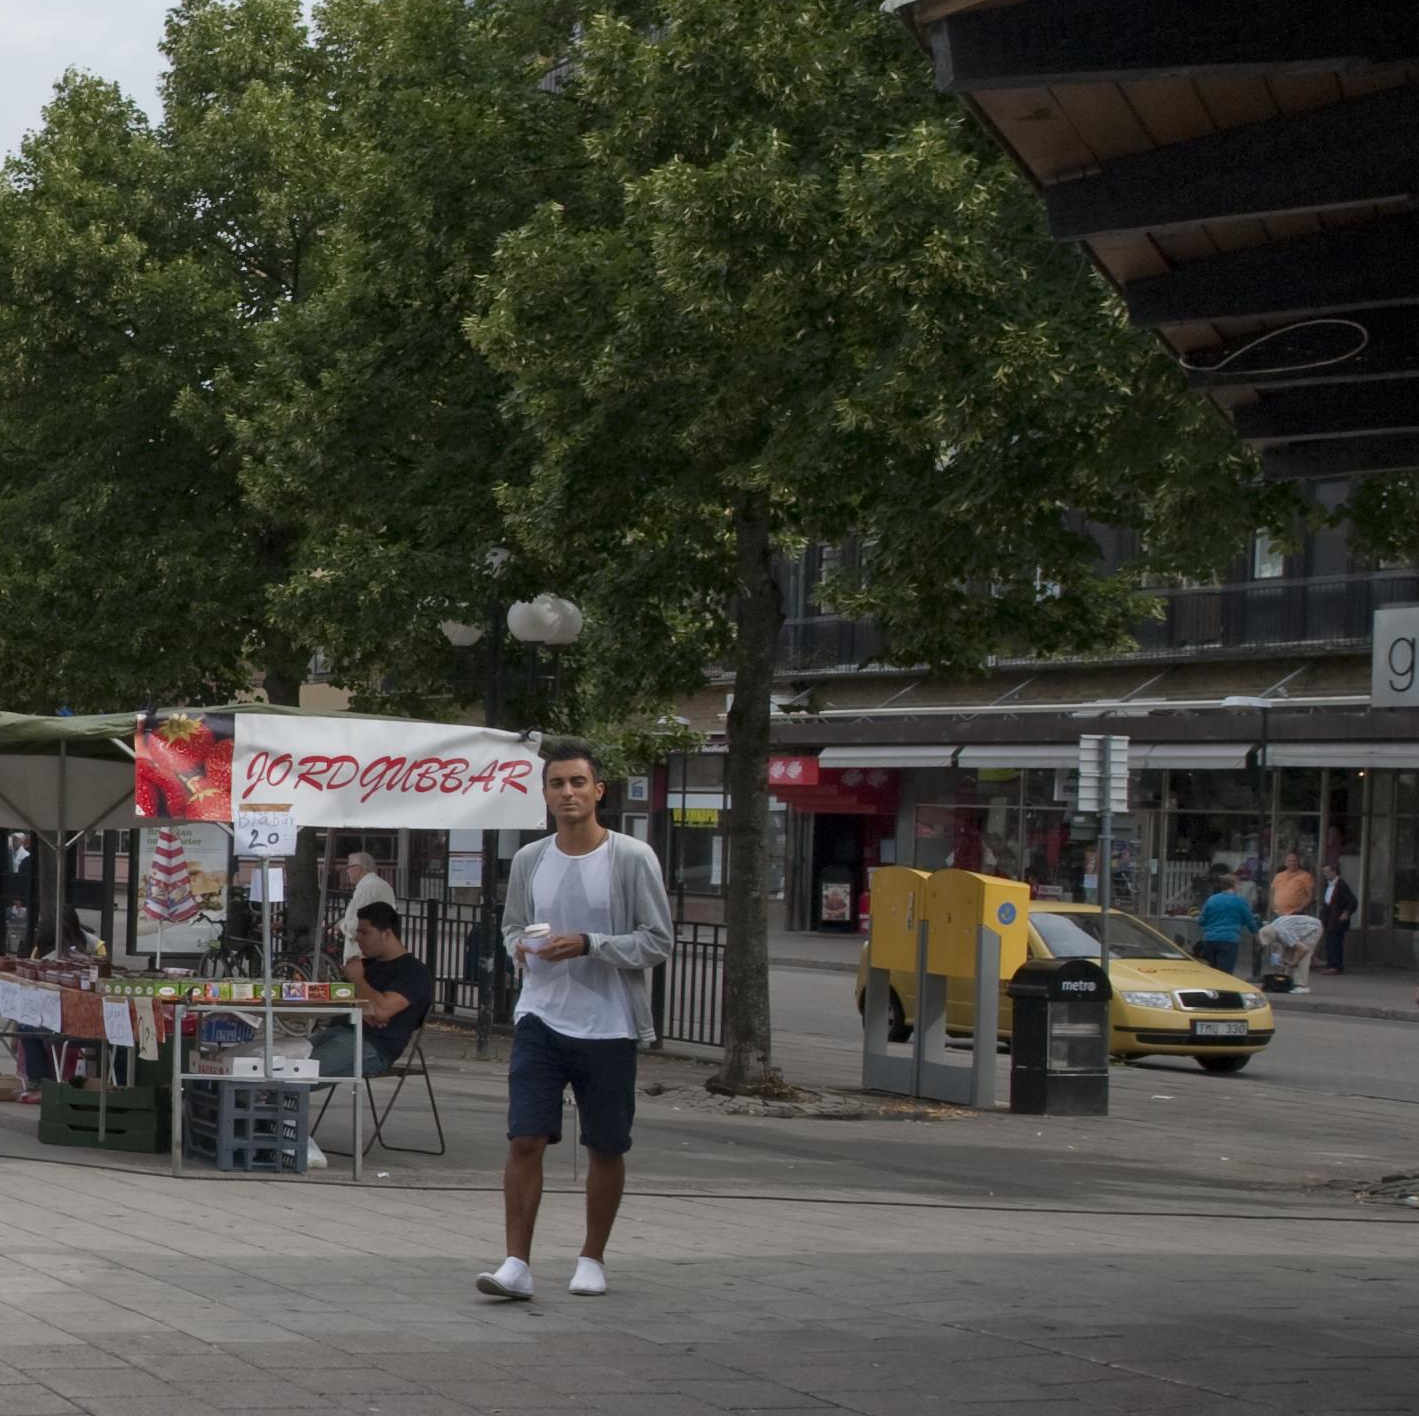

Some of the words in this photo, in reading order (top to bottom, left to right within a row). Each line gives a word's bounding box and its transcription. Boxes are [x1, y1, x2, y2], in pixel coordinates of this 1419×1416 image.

[242, 751, 533, 803] JORDGUBBAR
[1061, 980, 1097, 992] metro
[1225, 1023, 1246, 1034] 330
